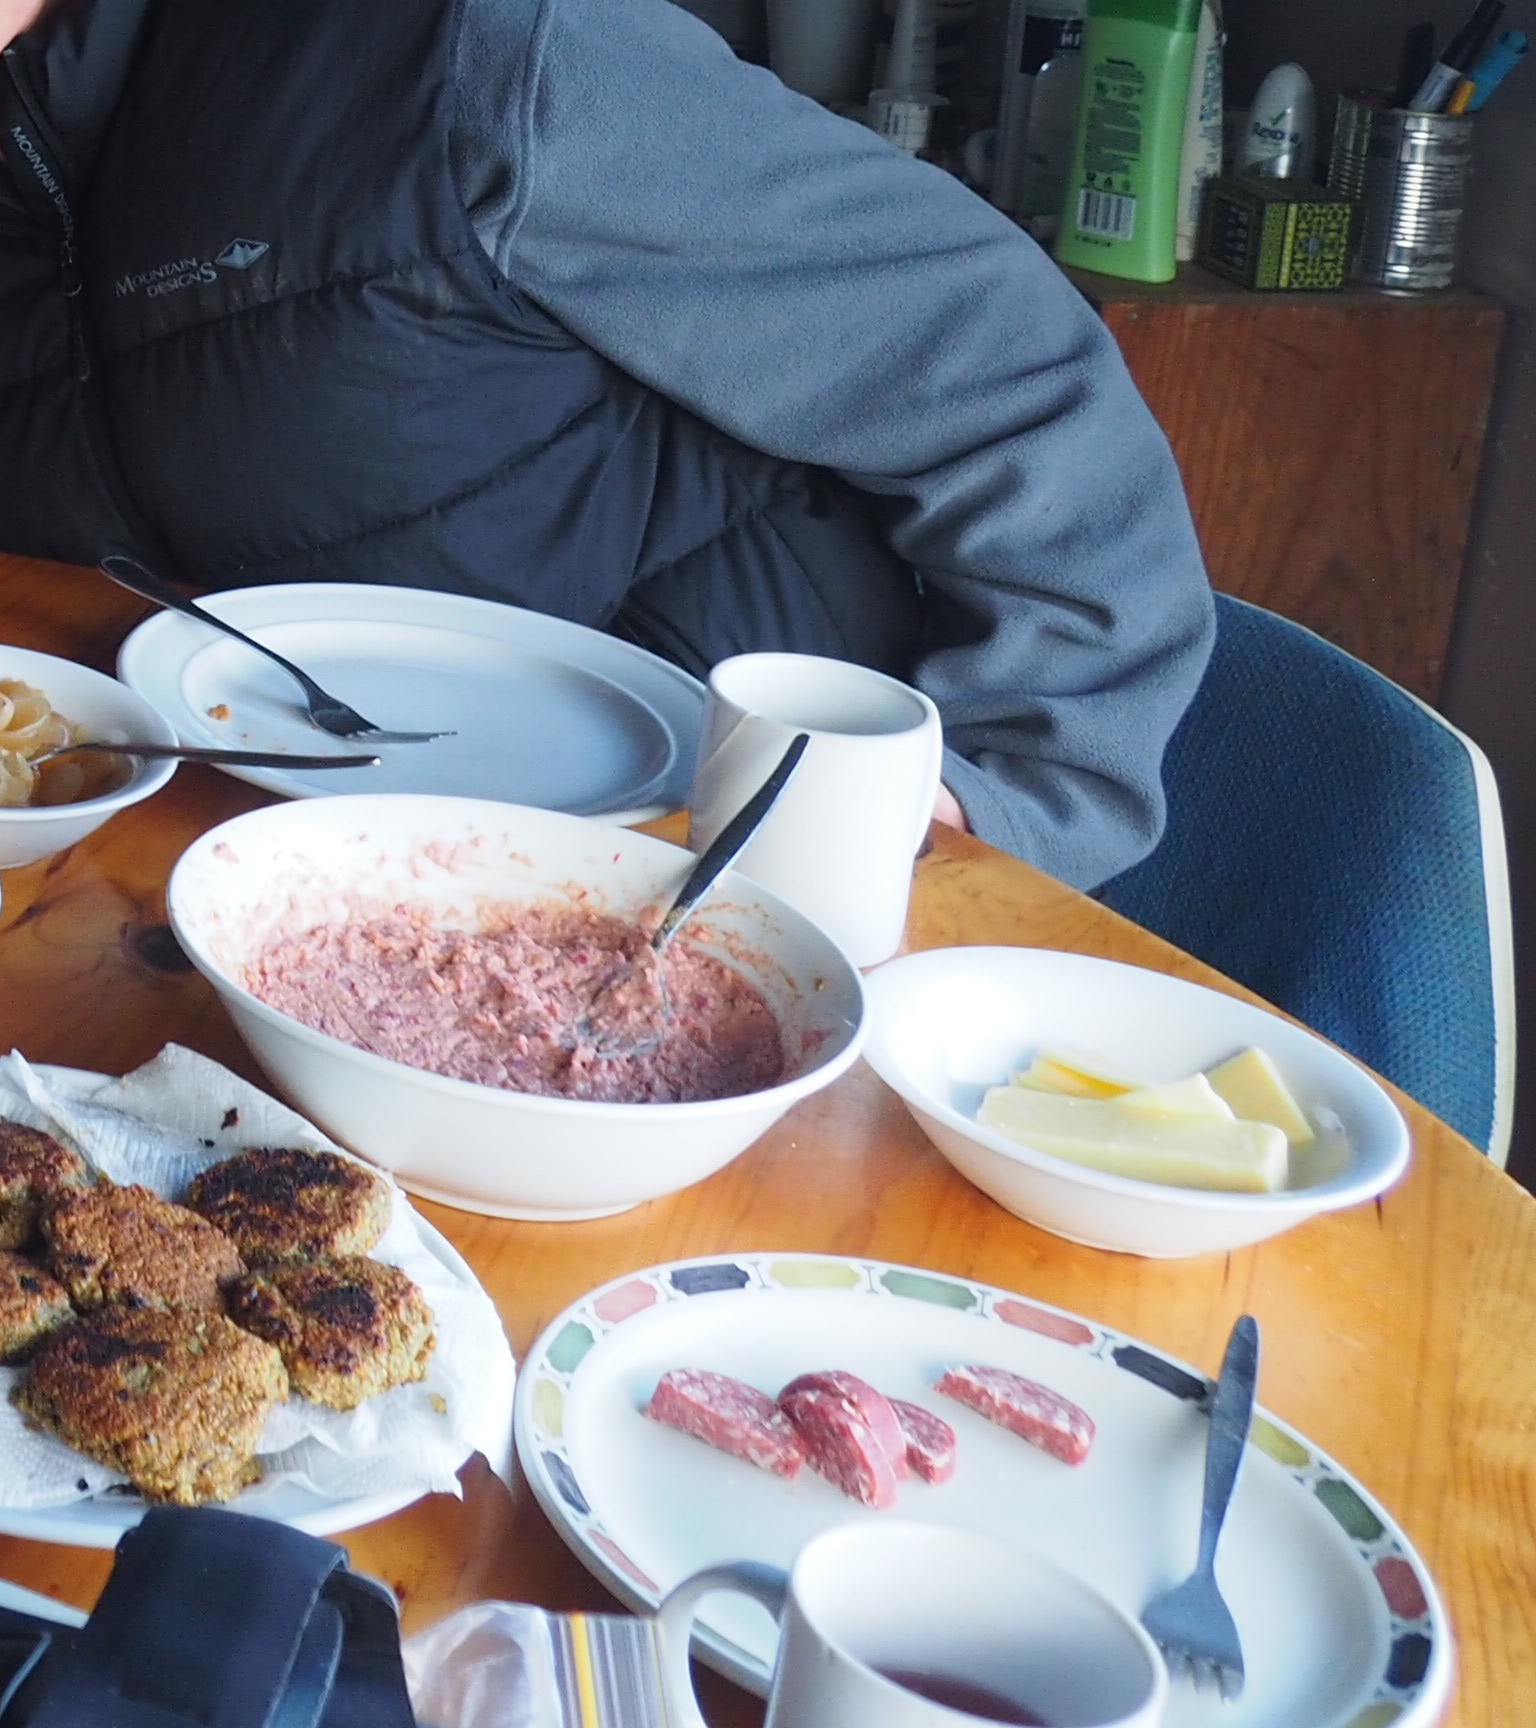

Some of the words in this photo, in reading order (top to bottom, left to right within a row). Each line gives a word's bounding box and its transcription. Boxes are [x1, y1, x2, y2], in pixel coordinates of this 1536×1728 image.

[1253, 121, 1300, 145] Rexoa
[11, 125, 61, 194] MOUNTAIN
[115, 256, 198, 298] MOUNTAIN
[145, 260, 218, 299] DESIGNS
